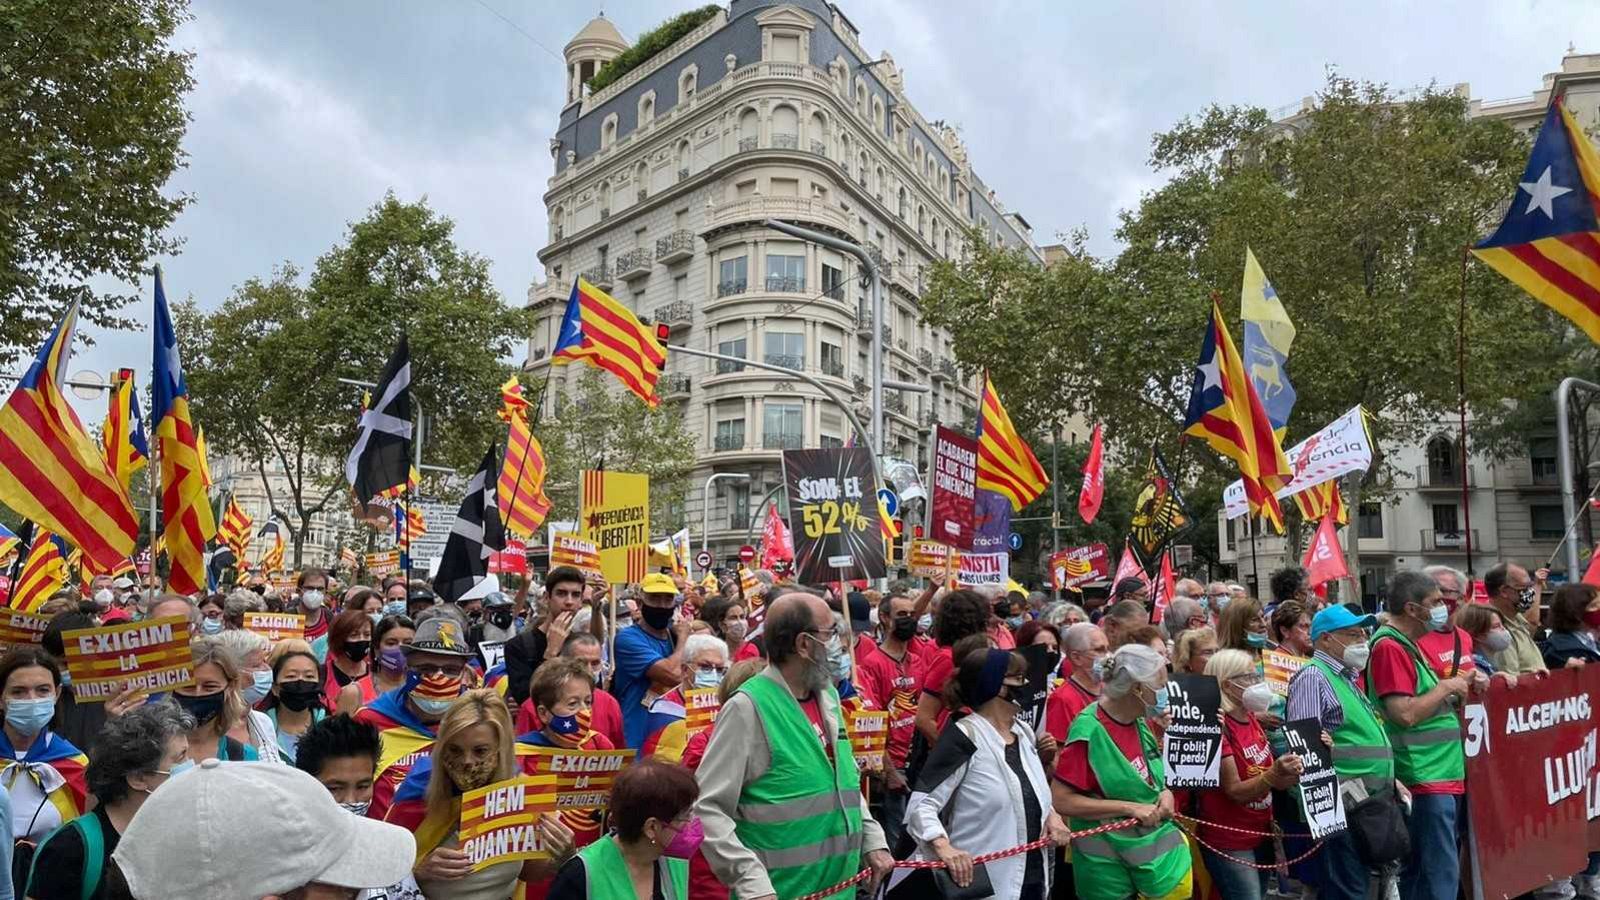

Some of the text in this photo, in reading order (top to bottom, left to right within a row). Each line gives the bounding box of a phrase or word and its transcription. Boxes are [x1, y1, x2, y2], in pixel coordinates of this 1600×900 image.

[937, 439, 976, 468] ACABAREM
[936, 455, 976, 484] EL QUE VAM
[798, 476, 862, 500] SOM EL
[935, 470, 975, 500] COMENÇAR
[803, 501, 868, 538] 52%
[560, 537, 597, 555] EXIGIM
[9, 614, 50, 632] EXIG
[251, 617, 299, 629] EXIGIM
[78, 623, 174, 654] EXIGIM
[269, 630, 280, 640] LA
[119, 653, 140, 672] LA
[1170, 740, 1206, 752] ni oblit
[1282, 724, 1308, 750] in,
[551, 755, 624, 773] EXIGIM
[1169, 752, 1206, 765] ni perdó
[574, 775, 590, 789] LA
[484, 784, 526, 819] HEM
[463, 825, 545, 864] GUANYA
